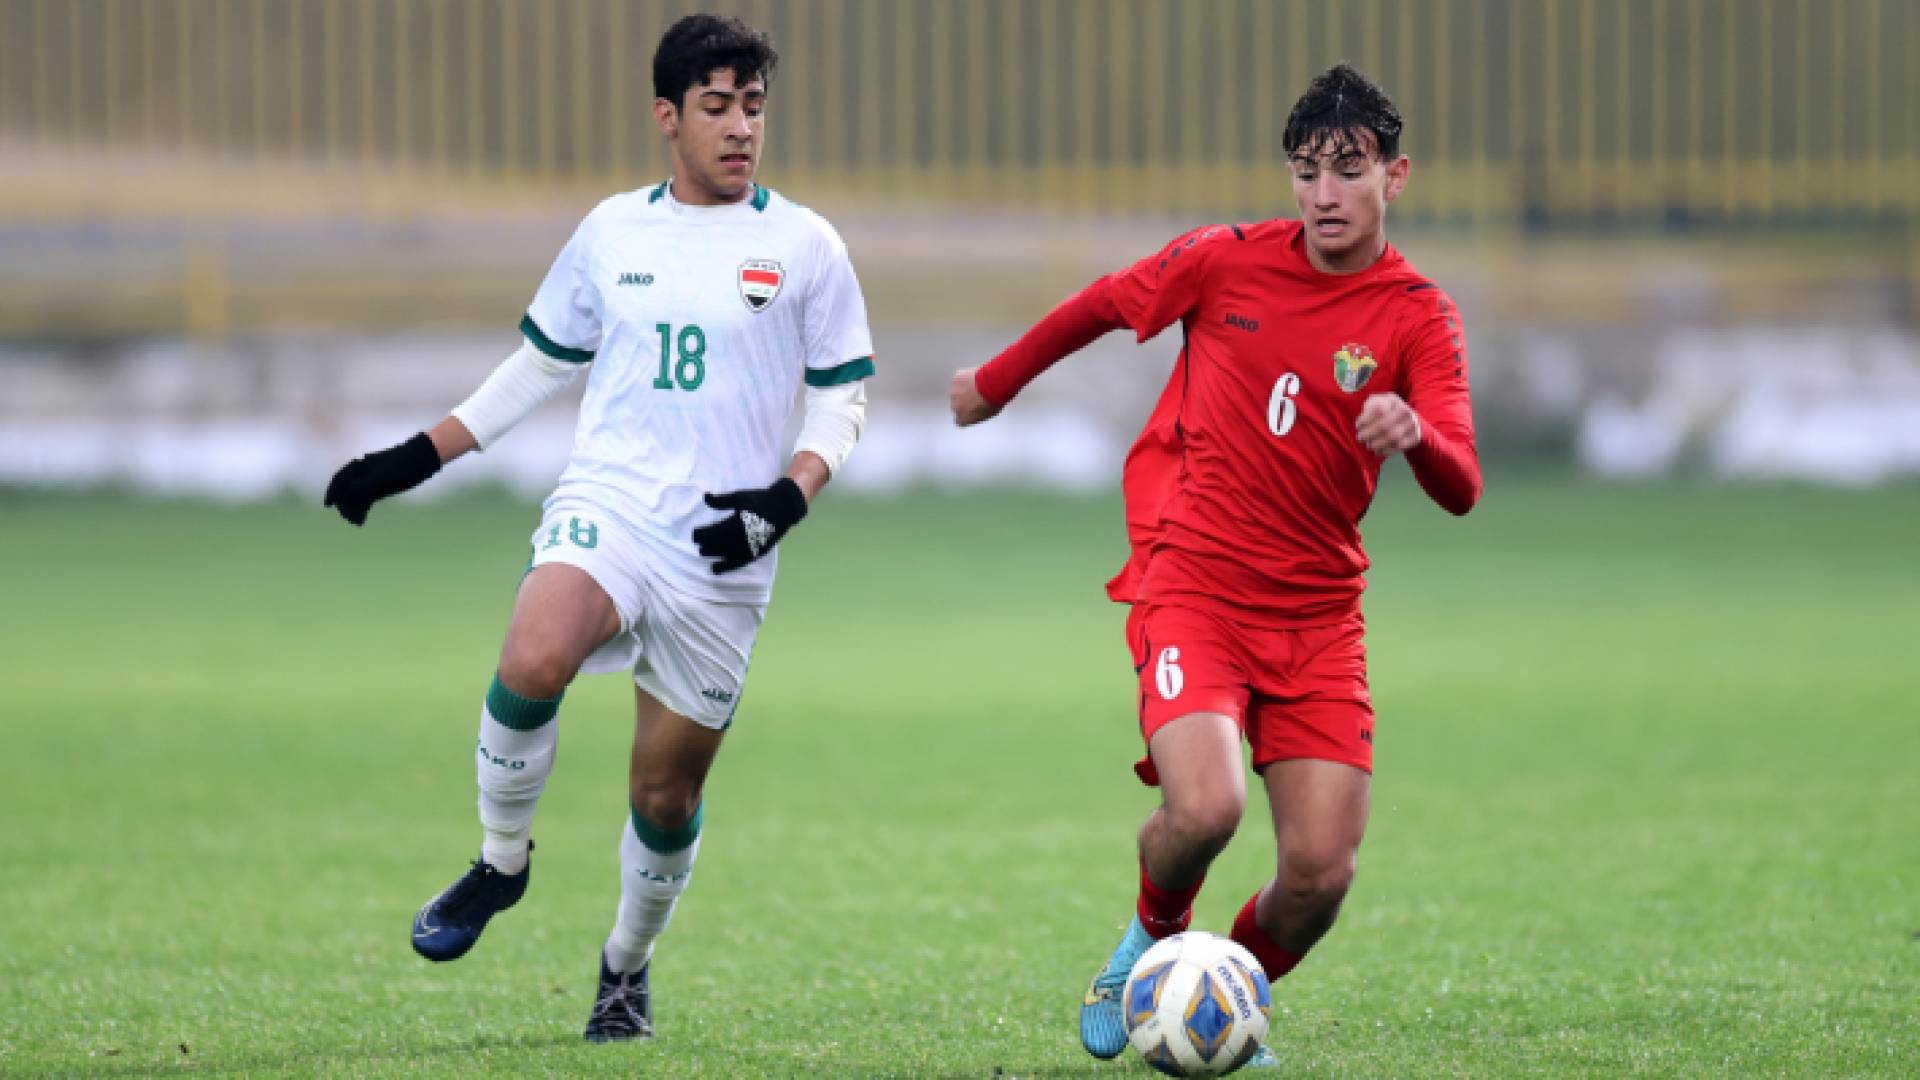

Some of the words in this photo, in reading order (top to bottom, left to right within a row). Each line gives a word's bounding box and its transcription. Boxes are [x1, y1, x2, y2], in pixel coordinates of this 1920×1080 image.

[617, 273, 654, 287] JAKO
[1225, 314, 1260, 334] JAKO
[651, 322, 706, 391] 18
[1268, 373, 1300, 437] 6
[1156, 647, 1183, 699] 6
[479, 744, 526, 770] AKO
